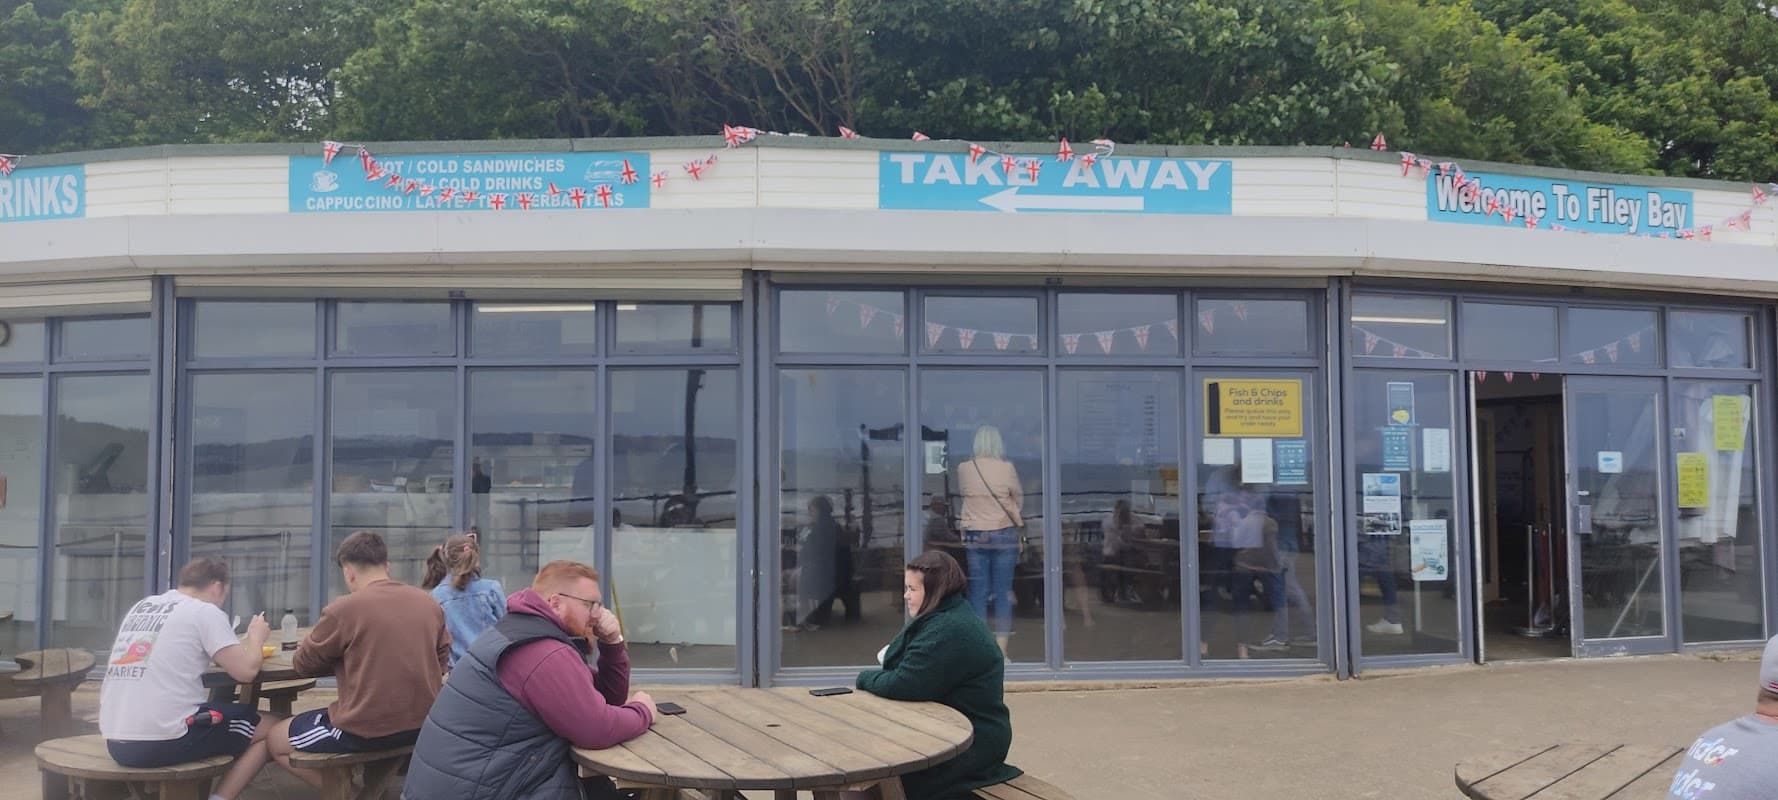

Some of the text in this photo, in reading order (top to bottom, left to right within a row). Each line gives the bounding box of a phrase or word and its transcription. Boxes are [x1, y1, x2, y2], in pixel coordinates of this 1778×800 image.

[416, 160, 457, 173] COLD
[463, 159, 565, 173] SANDWICHES
[890, 153, 1223, 191] TAKE AWAY
[438, 177, 480, 190] COLD
[485, 176, 543, 191] DRINKS
[306, 195, 402, 210] CAPPUCCINO
[1433, 173, 1688, 239] Welcome To Filey Bay
[1228, 387, 1248, 397] Fish
[1259, 388, 1287, 399] Chips
[1231, 397, 1283, 406] and drinks
